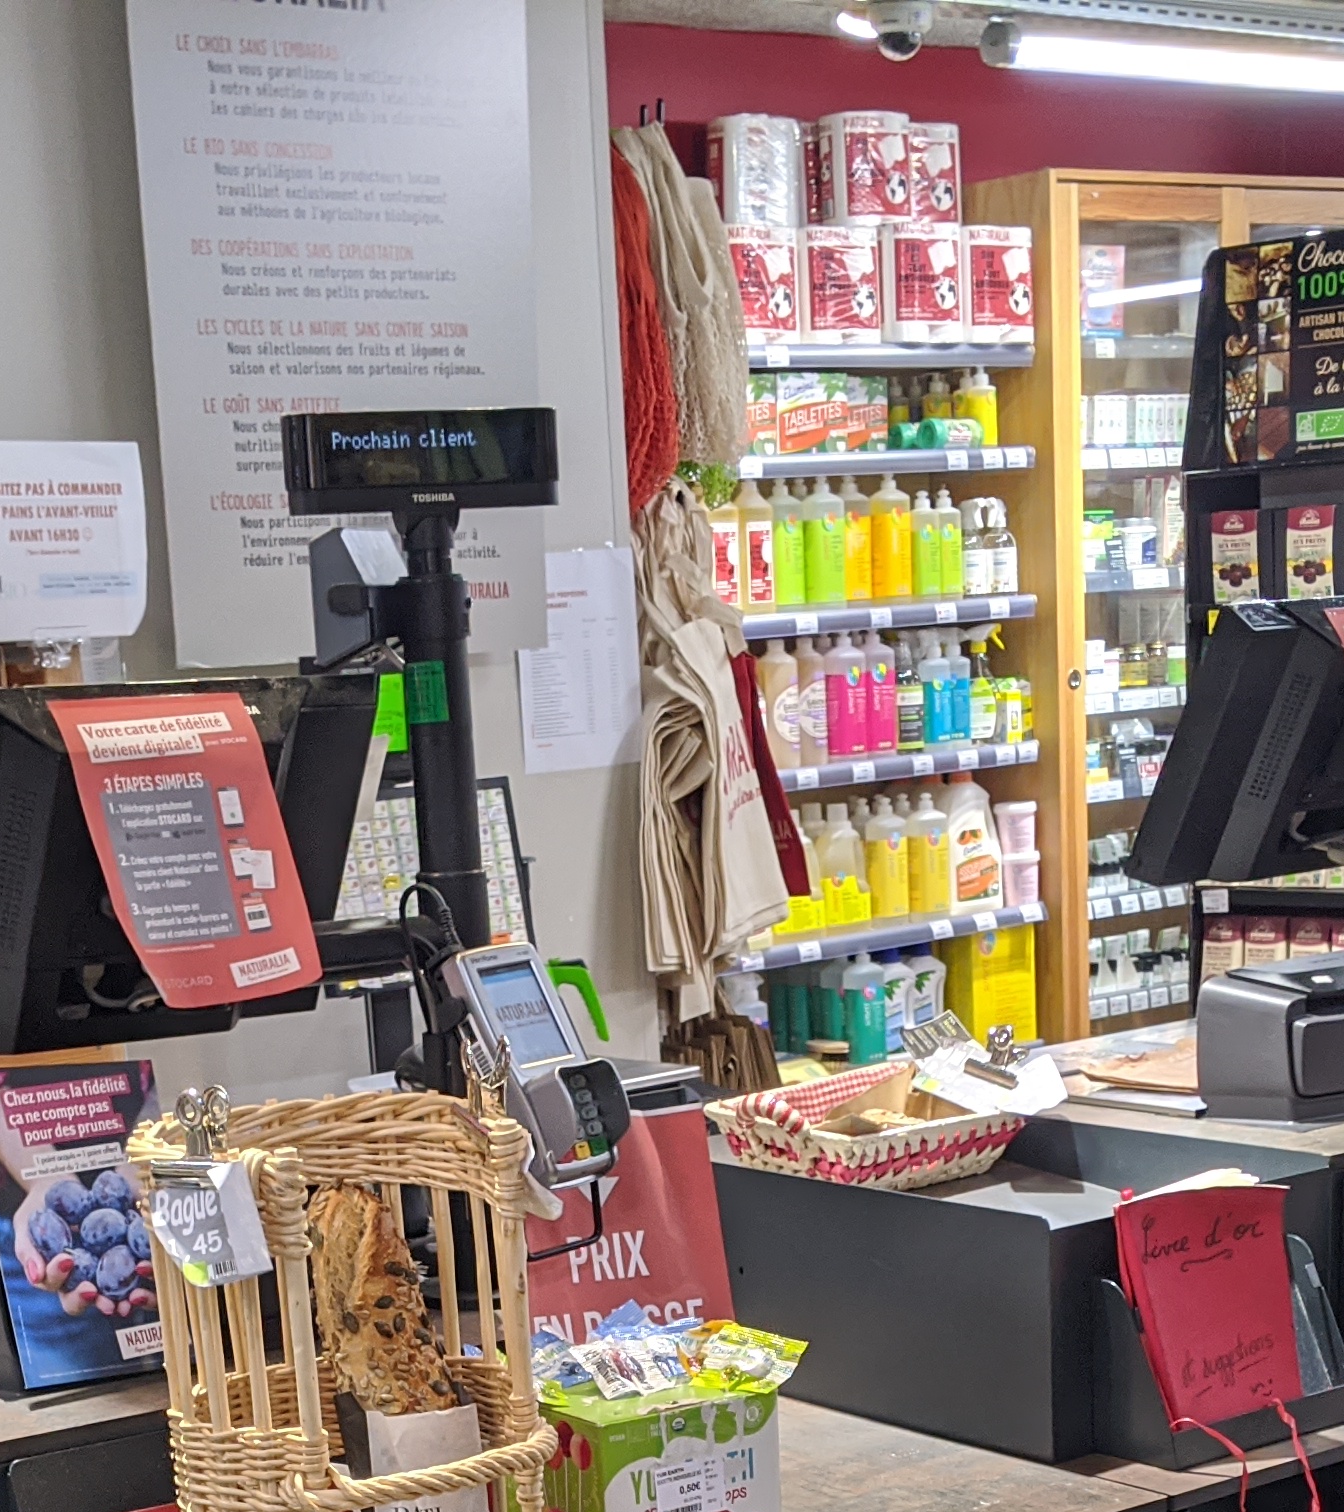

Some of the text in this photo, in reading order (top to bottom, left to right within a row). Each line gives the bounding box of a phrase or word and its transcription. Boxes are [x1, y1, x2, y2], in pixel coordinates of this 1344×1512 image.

[191, 237, 415, 261] DES COOPÉRATIONS SANS EXPLOITATION
[197, 318, 470, 338] LES CYCLES DE LA NATURE SANS CONTRE SAISON
[1299, 312, 1336, 328] ARTISAN
[227, 341, 466, 360] Nous sélectionnons des fruits et légumes de
[1316, 356, 1338, 376] De
[1327, 377, 1341, 394] la
[783, 401, 842, 429] TABLETTES
[331, 428, 477, 451] Prochain client
[25, 482, 45, 497] PAS
[47, 479, 56, 496] À
[57, 482, 123, 497] COMMANDER
[412, 493, 456, 503] TOSHIBA
[2, 506, 34, 520] PAINS
[9, 528, 80, 543] AVANT 16H30
[83, 714, 223, 740] Votre carte de fidélité
[91, 741, 143, 760] devient
[103, 771, 204, 795] 3 ÉTAPES SIMPLES
[237, 953, 292, 977] NATURALIA
[495, 999, 550, 1022] NATURALIA
[3, 1073, 127, 1109] Chez nous, la fidélité
[8, 1100, 110, 1128] ça ne compte pas
[24, 1117, 123, 1146] pour des prunes.
[1141, 1213, 1190, 1265] Livre
[568, 1229, 650, 1284] PRIX
[679, 1481, 701, 1495] 0,50€
